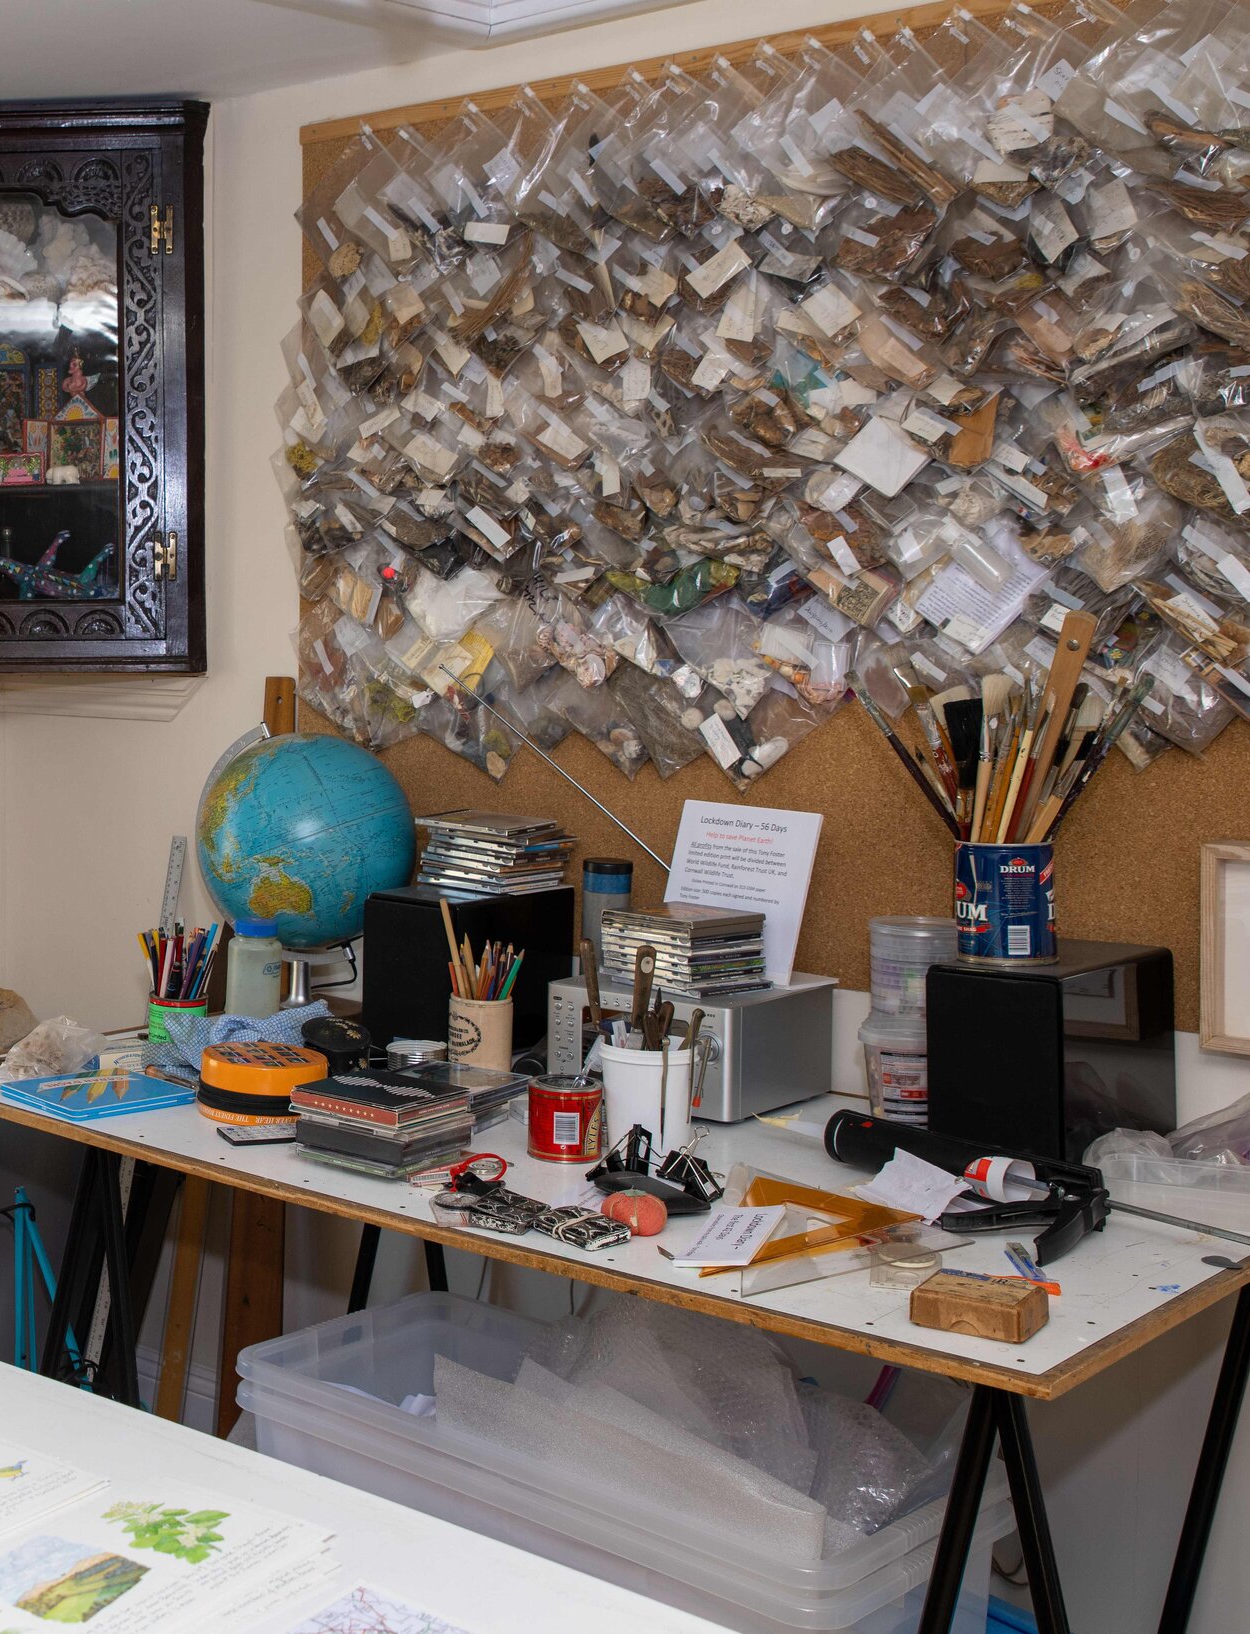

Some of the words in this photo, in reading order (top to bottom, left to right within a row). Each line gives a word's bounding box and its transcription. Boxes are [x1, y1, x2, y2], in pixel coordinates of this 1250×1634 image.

[701, 816, 733, 826] Lockdown
[736, 820, 753, 830] Diary
[761, 822, 769, 831] 56
[770, 824, 787, 834] Days
[738, 834, 756, 843] Planet
[758, 849, 769, 857] Tony
[747, 857, 764, 865] divided
[765, 859, 786, 867] between
[731, 864, 754, 872] Rainforest
[756, 866, 767, 874] Trust
[1000, 865, 1035, 873] DRUM
[753, 896, 773, 904] numbered
[215, 1111, 233, 1120] FINEST
[255, 1116, 274, 1124] HEAR
[742, 1213, 768, 1234] Lockdown
[731, 1235, 752, 1246] Diary
